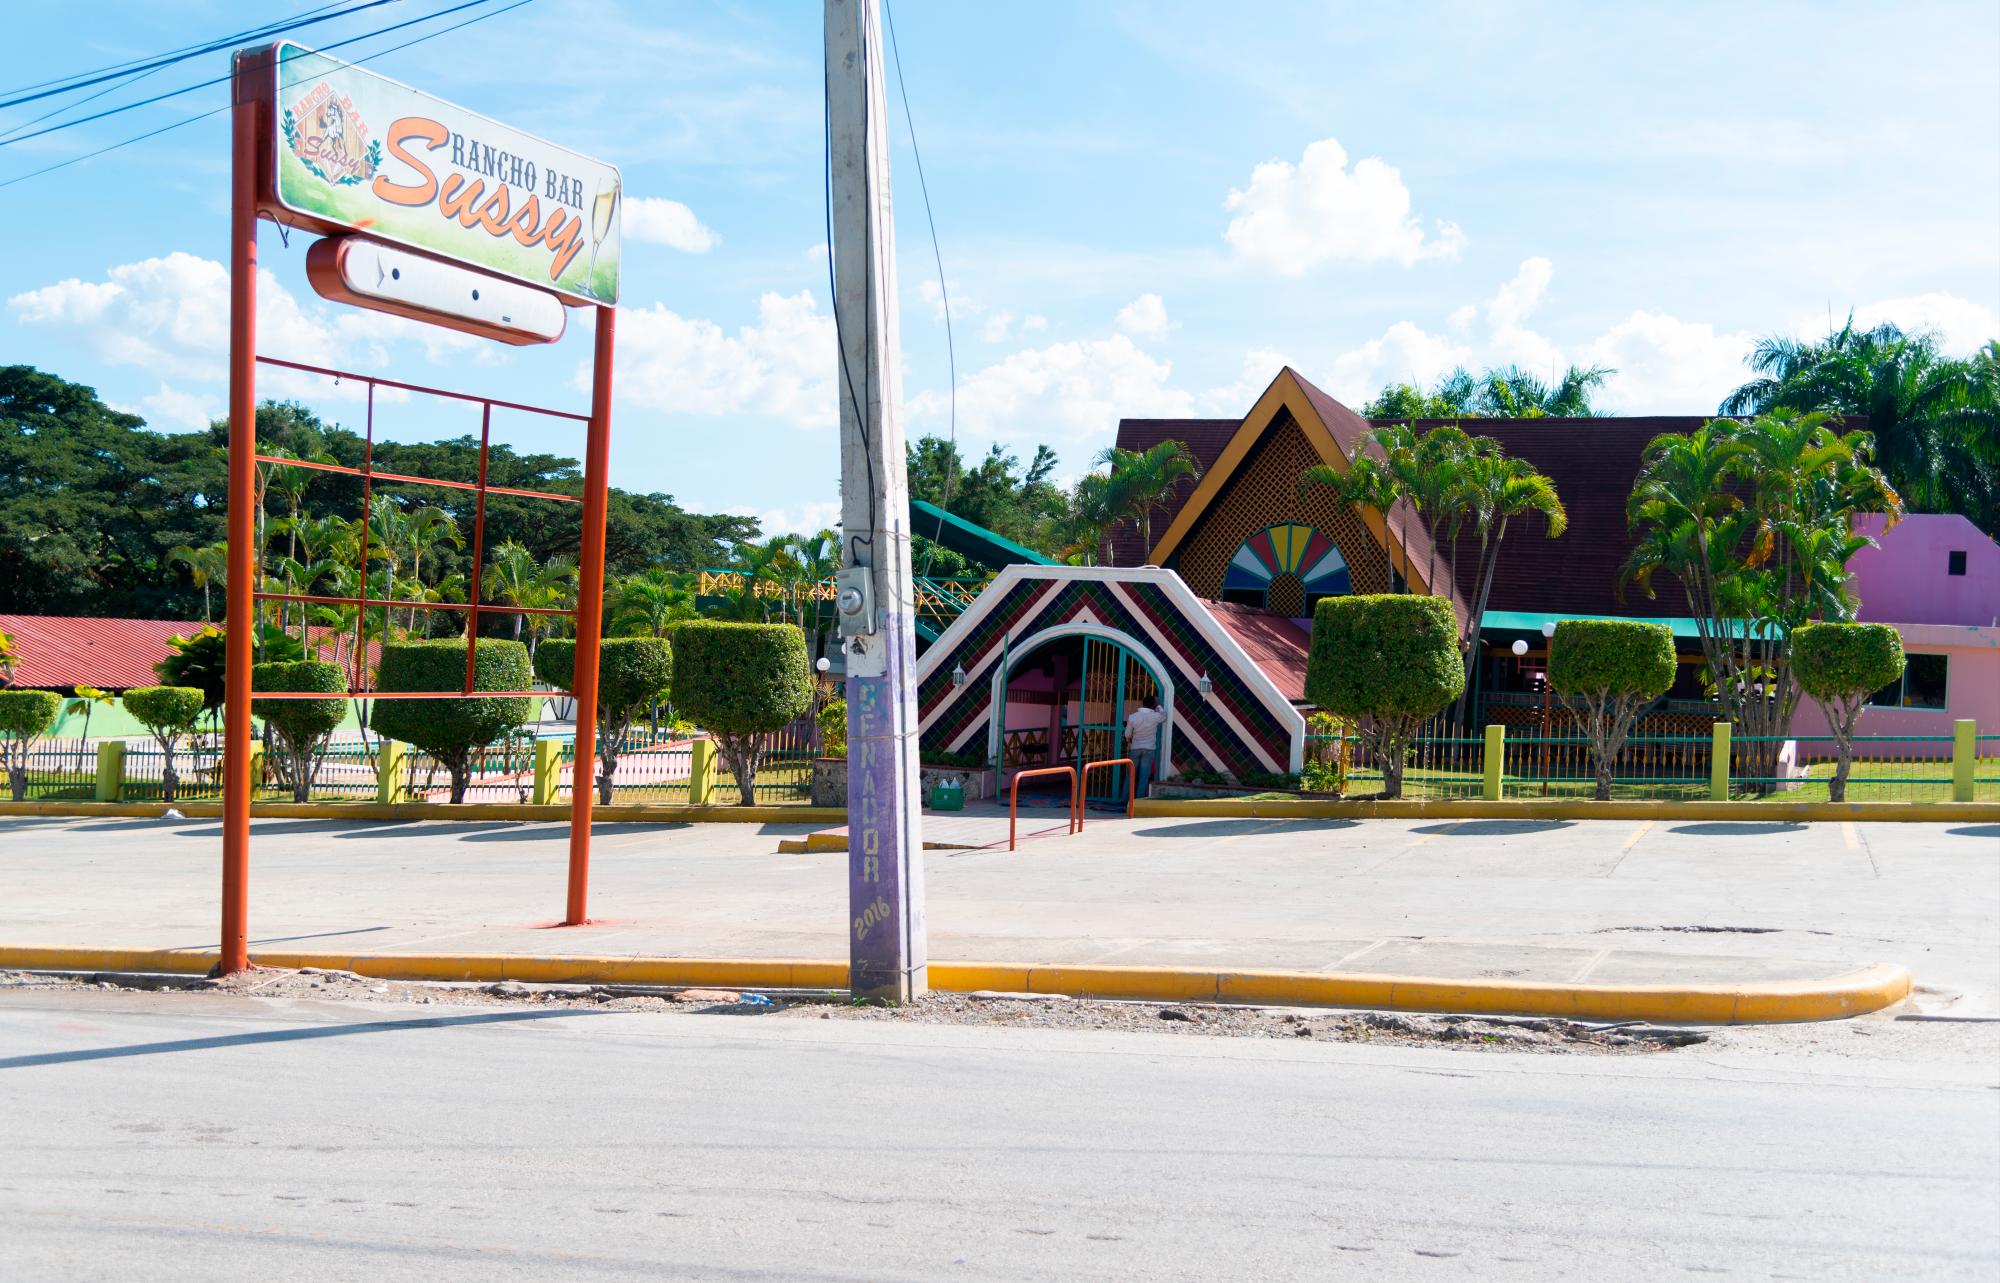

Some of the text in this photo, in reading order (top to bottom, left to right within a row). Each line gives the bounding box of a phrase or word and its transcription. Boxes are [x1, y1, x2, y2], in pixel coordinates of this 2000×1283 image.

[304, 135, 360, 175] Sussy
[450, 132, 584, 211] RANCHO BAR
[372, 116, 585, 282] Sussy
[854, 895, 890, 941] 2016
